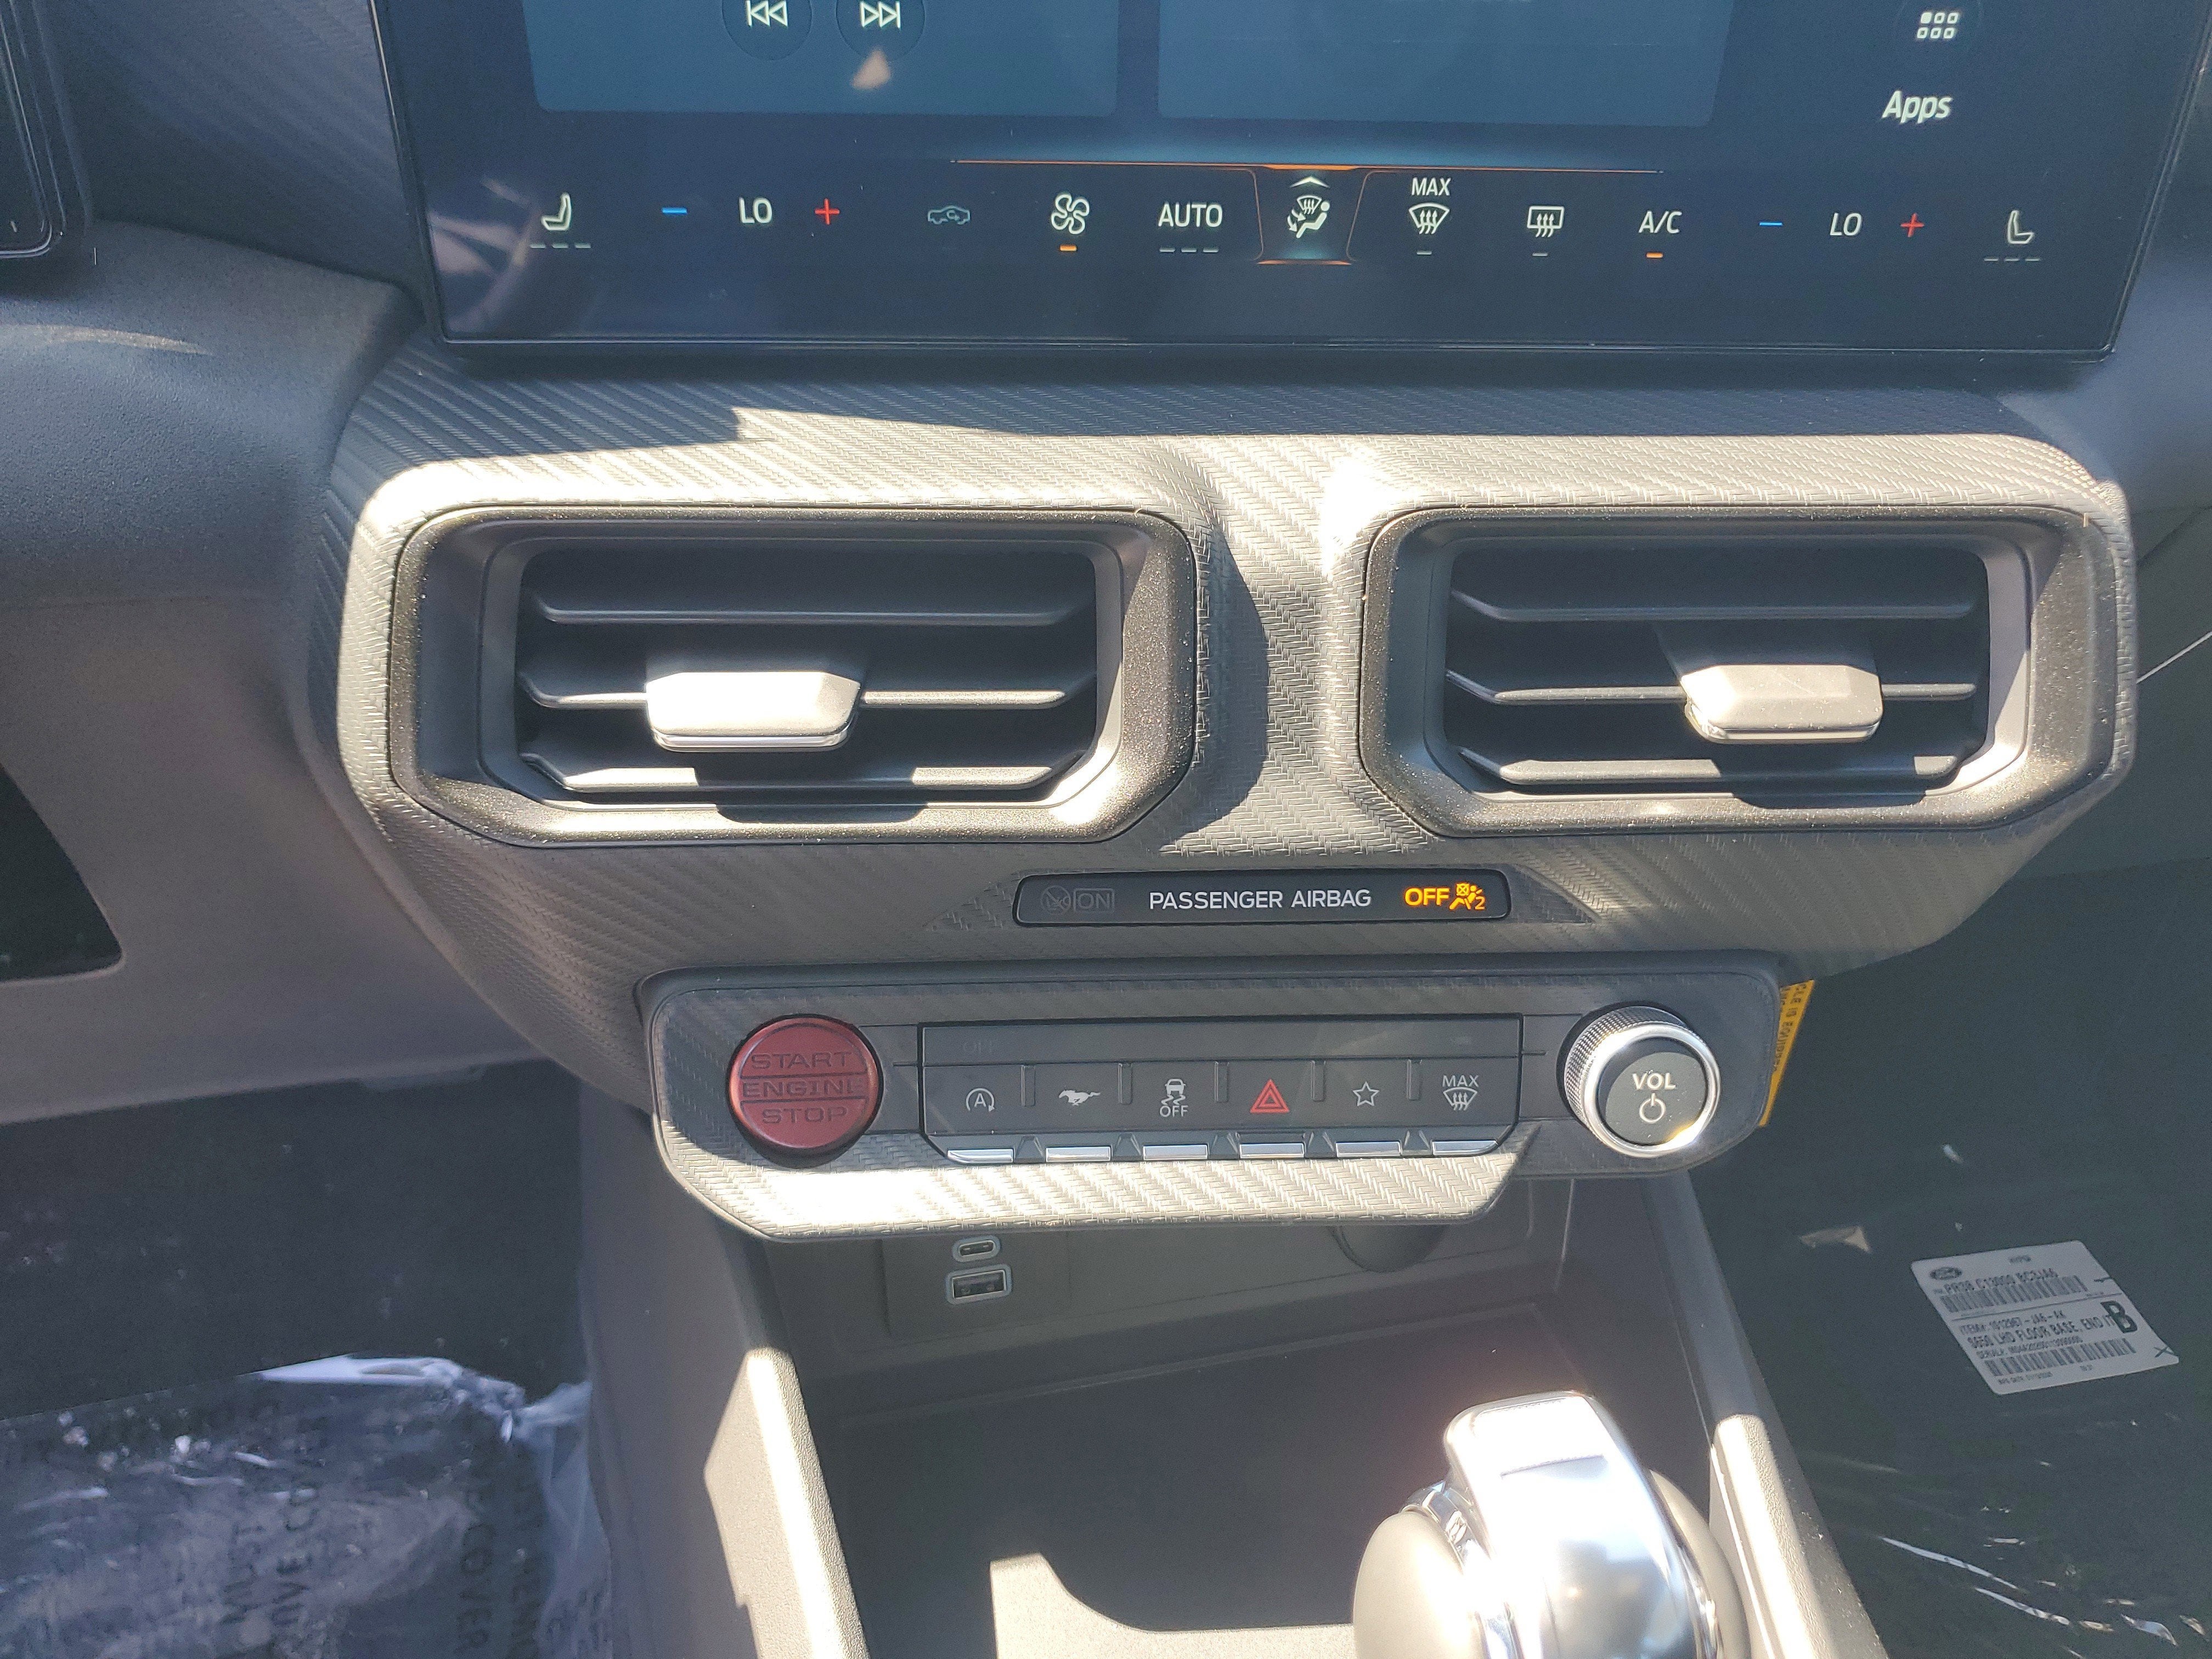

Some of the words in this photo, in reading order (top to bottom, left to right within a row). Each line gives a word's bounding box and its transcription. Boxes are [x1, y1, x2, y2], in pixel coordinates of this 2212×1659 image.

[1882, 90, 1952, 124] Apps
[1411, 177, 1451, 196] MAX
[740, 198, 773, 224] LO
[1158, 203, 1223, 228] AUTO
[1638, 211, 1683, 234] A/C
[1830, 212, 1863, 236] LO
[1077, 892, 1110, 910] ON
[1149, 891, 1283, 910] PASSENGER
[1291, 889, 1372, 908] AIRBAG
[1404, 888, 1450, 906] OFF
[751, 1051, 851, 1069] START
[1442, 1075, 1479, 1087] MAX
[1633, 1072, 1676, 1090] VOL
[762, 1106, 848, 1124] STOP
[1159, 1104, 1188, 1118] OFF
[2101, 1300, 2138, 1334] B
[2016, 1325, 2051, 1341] FLOOR
